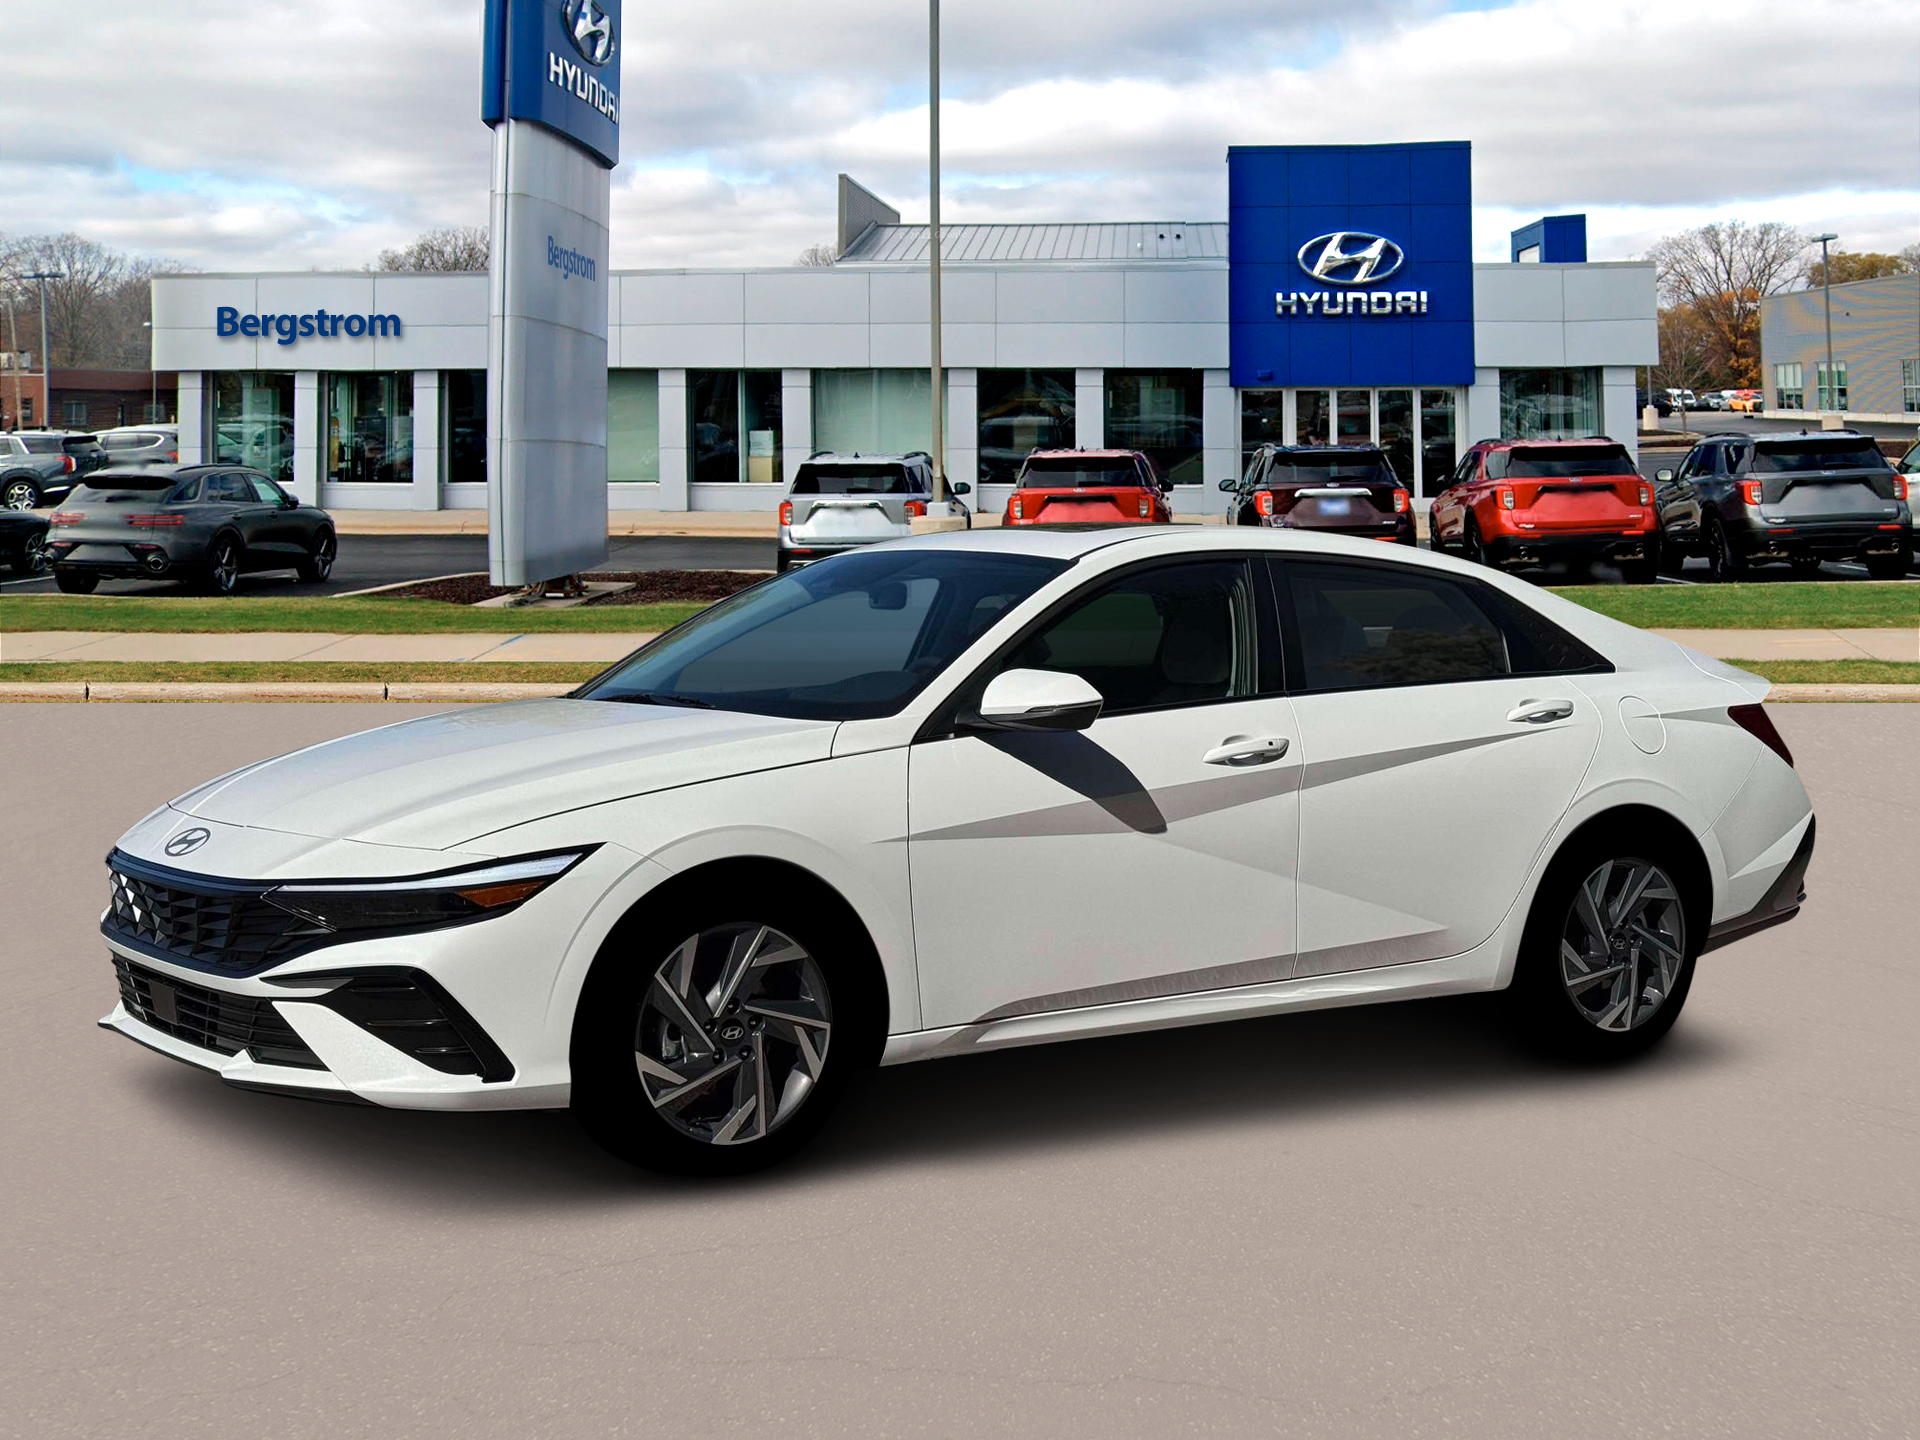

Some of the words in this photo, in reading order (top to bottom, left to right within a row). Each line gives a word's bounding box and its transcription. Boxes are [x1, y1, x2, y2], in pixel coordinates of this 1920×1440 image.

[549, 52, 619, 124] HYUNDAI
[548, 235, 596, 282] Bergstrom
[1275, 290, 1428, 315] HYUNDAI
[217, 306, 401, 346] Bergstrom
